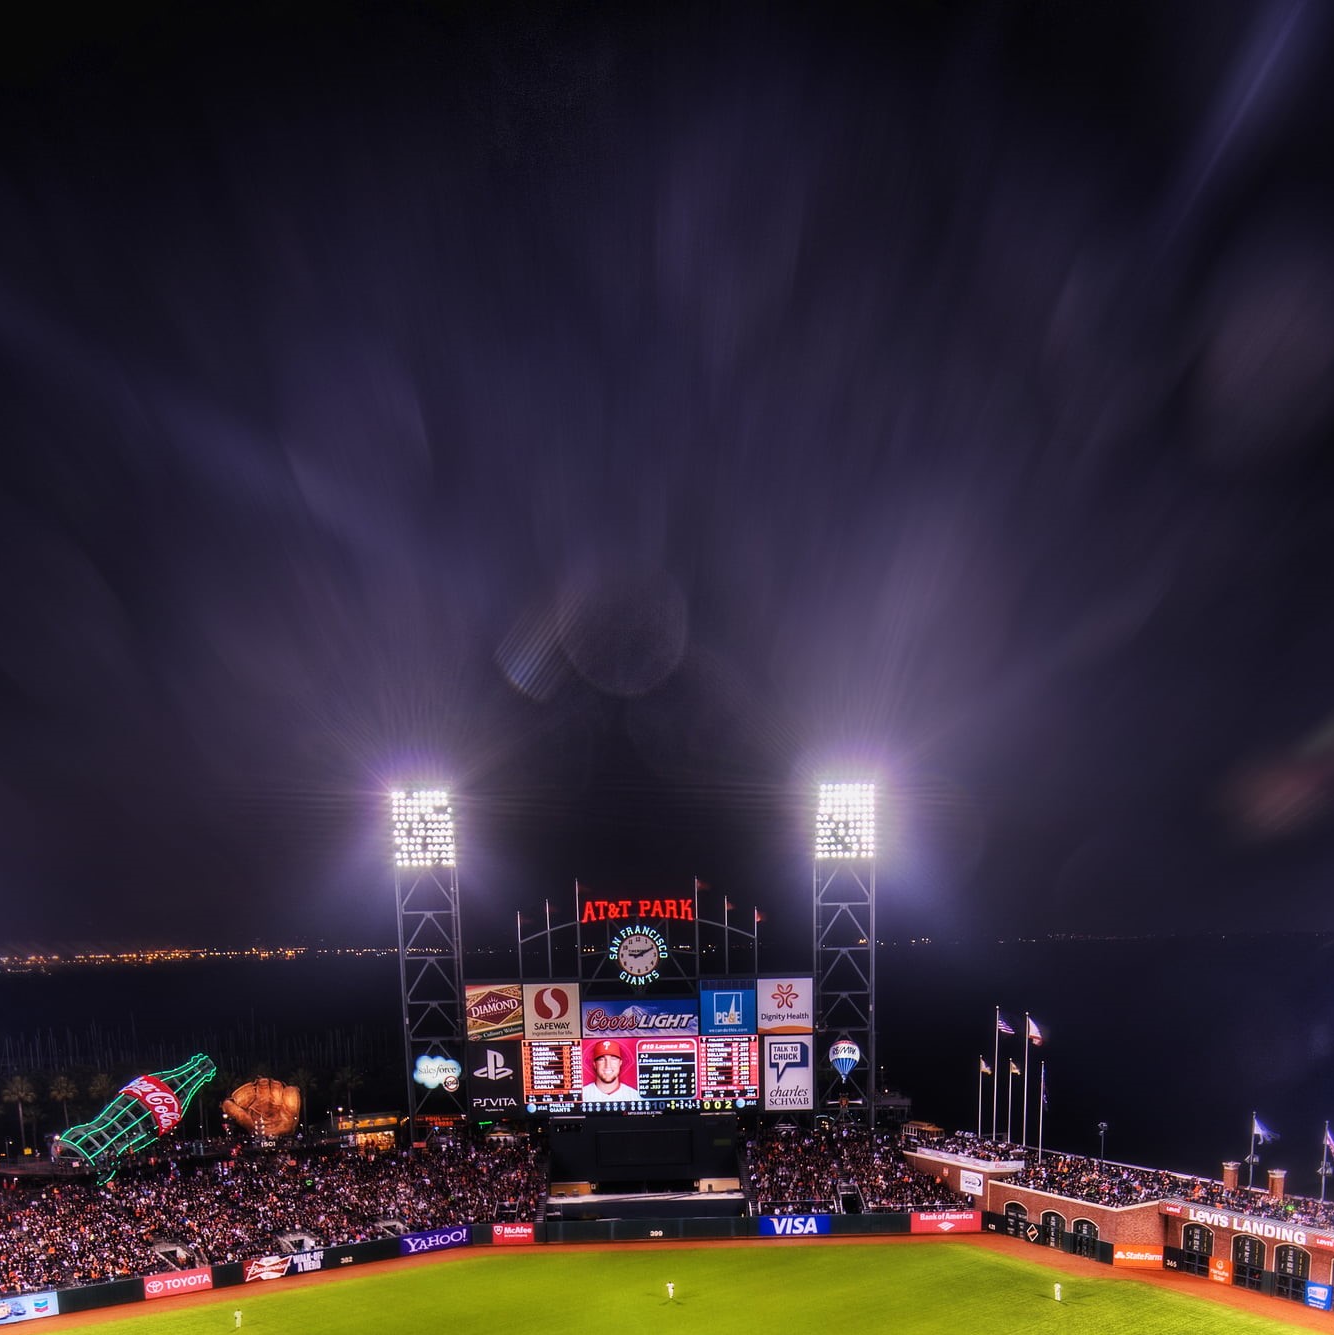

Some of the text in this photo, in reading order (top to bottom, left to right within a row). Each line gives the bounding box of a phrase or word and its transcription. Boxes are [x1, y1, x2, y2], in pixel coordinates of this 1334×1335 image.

[581, 899, 694, 923] AT&T PARK
[609, 925, 668, 960] SAN FRANCISCO
[619, 969, 660, 986] GIANTS
[471, 998, 519, 1018] DIAMOND
[587, 1007, 694, 1030] Coors LIGHT
[716, 1012, 741, 1024] PG&E
[760, 1013, 786, 1022] Dignity
[534, 1022, 570, 1030] SAFEWAY
[832, 1046, 856, 1055] RE/MAX
[418, 1064, 456, 1078] salesforce
[770, 1085, 808, 1097] charles
[769, 1097, 809, 1105] SCHWAB
[770, 1217, 818, 1234] VISA
[1233, 1218, 1306, 1245] LANDING
[403, 1228, 467, 1253] YAHOO!
[293, 1250, 324, 1264] WALK-OFF
[164, 1274, 211, 1290] TOYOTA
